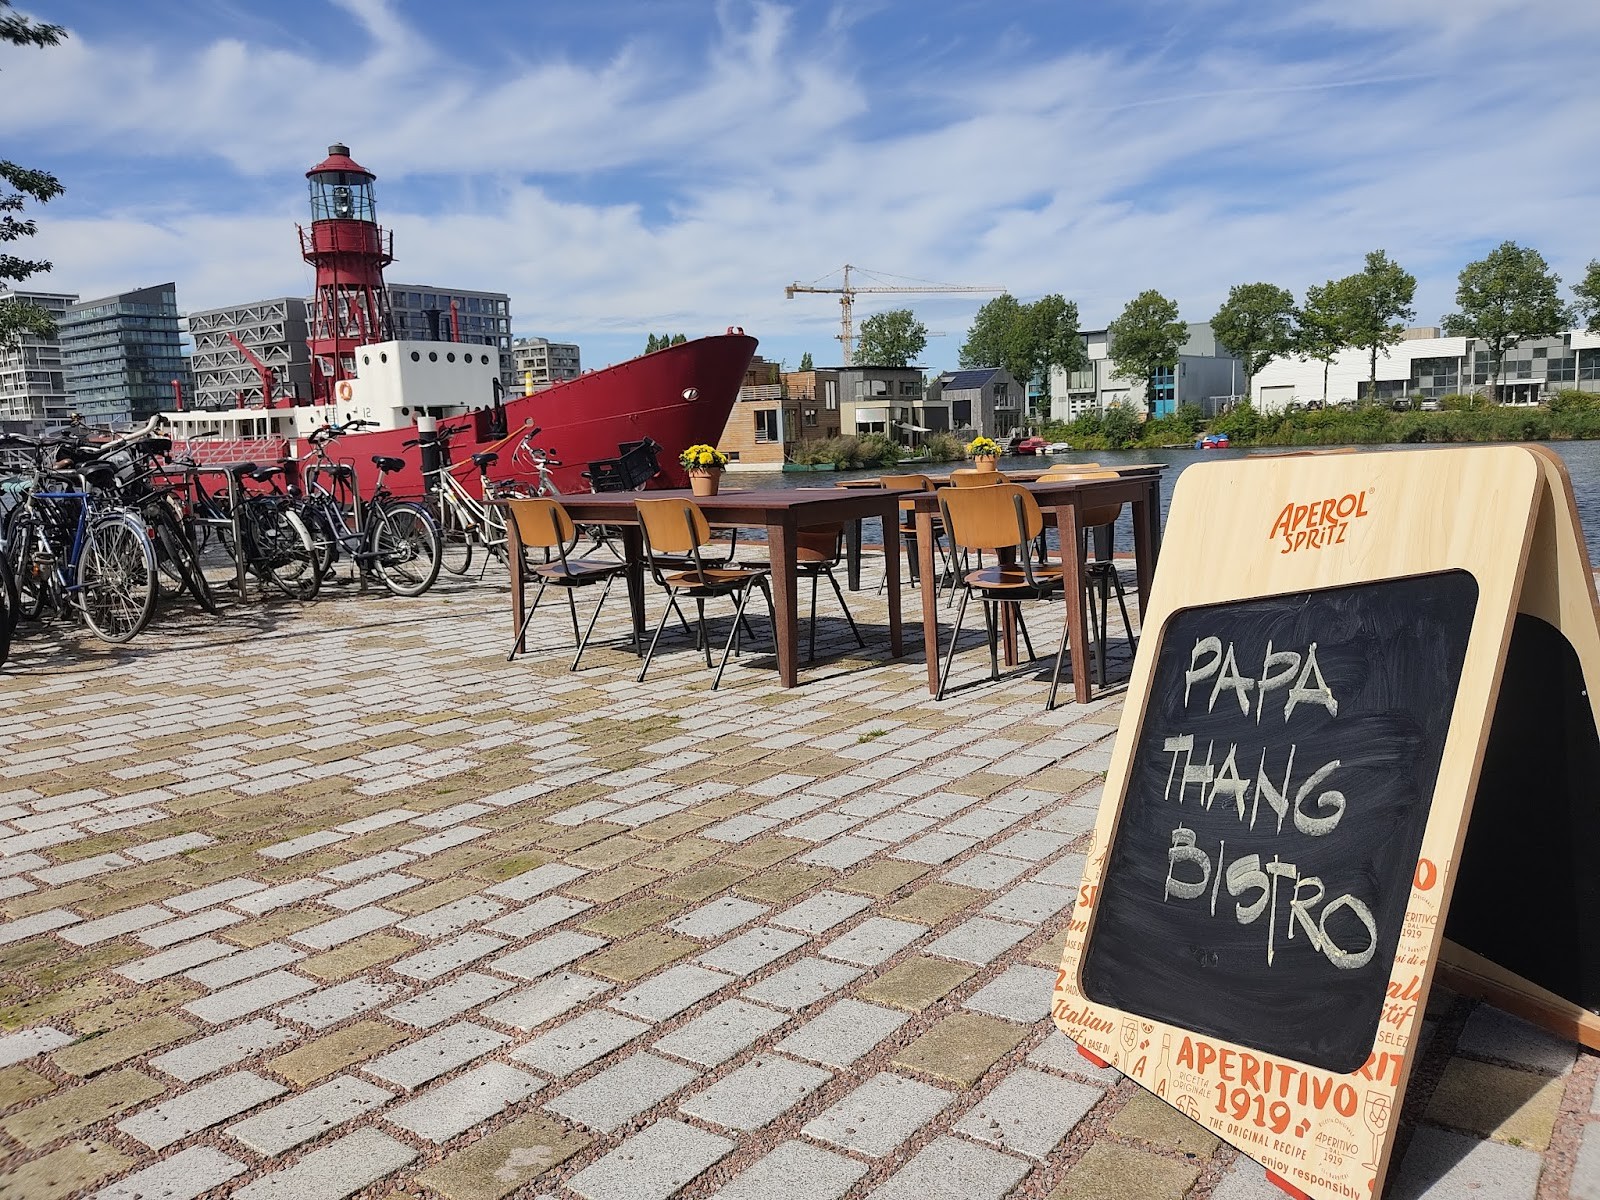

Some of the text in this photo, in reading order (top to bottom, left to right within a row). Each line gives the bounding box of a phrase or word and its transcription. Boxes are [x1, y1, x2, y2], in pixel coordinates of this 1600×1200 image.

[363, 407, 371, 418] 12
[1269, 491, 1368, 539] APEROL
[1184, 636, 1338, 726] PAPA
[1162, 733, 1346, 836] THANG
[1164, 822, 1378, 970] BISTRO
[1401, 928, 1422, 939] 1919
[1052, 999, 1116, 1035] Italian
[1088, 1039, 1102, 1052] BASE
[1103, 1043, 1110, 1054] DI
[1172, 1079, 1211, 1099] ORIGINALE
[1176, 1036, 1358, 1117] APERITIVO
[1179, 1071, 1209, 1089] RICETTA
[1215, 1082, 1291, 1135] 1919
[1209, 1117, 1223, 1130] THE
[1227, 1123, 1269, 1147] ORIGINAL
[1273, 1139, 1307, 1160] RECIPE
[1315, 1131, 1359, 1155] APERITIVO
[1261, 1155, 1361, 1200] enjoy responsibly
[1323, 1152, 1343, 1166] 1919
